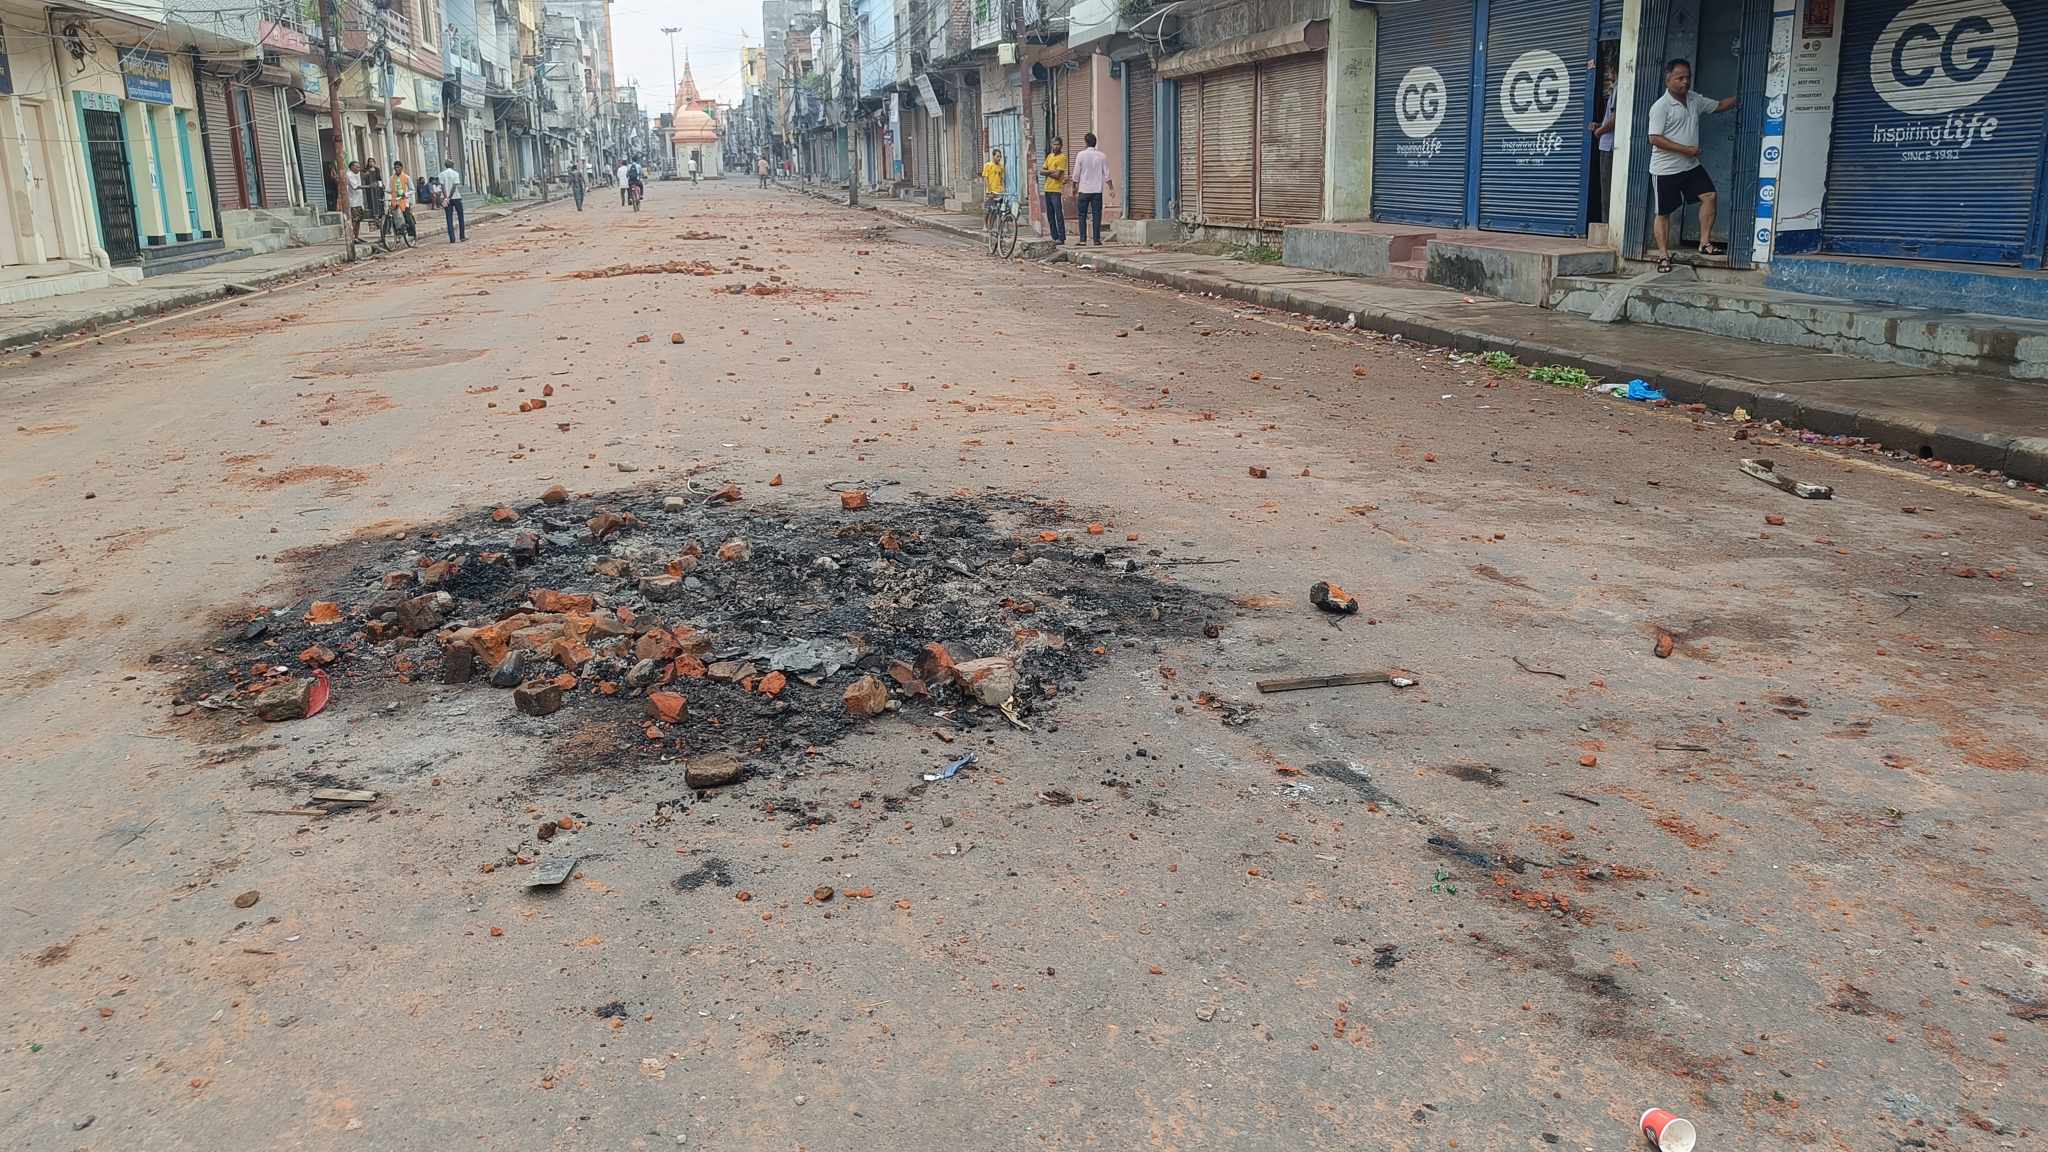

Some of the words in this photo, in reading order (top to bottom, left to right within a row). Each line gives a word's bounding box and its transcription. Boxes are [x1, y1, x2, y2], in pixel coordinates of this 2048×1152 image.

[1891, 16, 1996, 87] CG
[1403, 82, 1438, 121] CG
[1510, 68, 1559, 114] CG
[1902, 151, 1931, 160] SINCE
